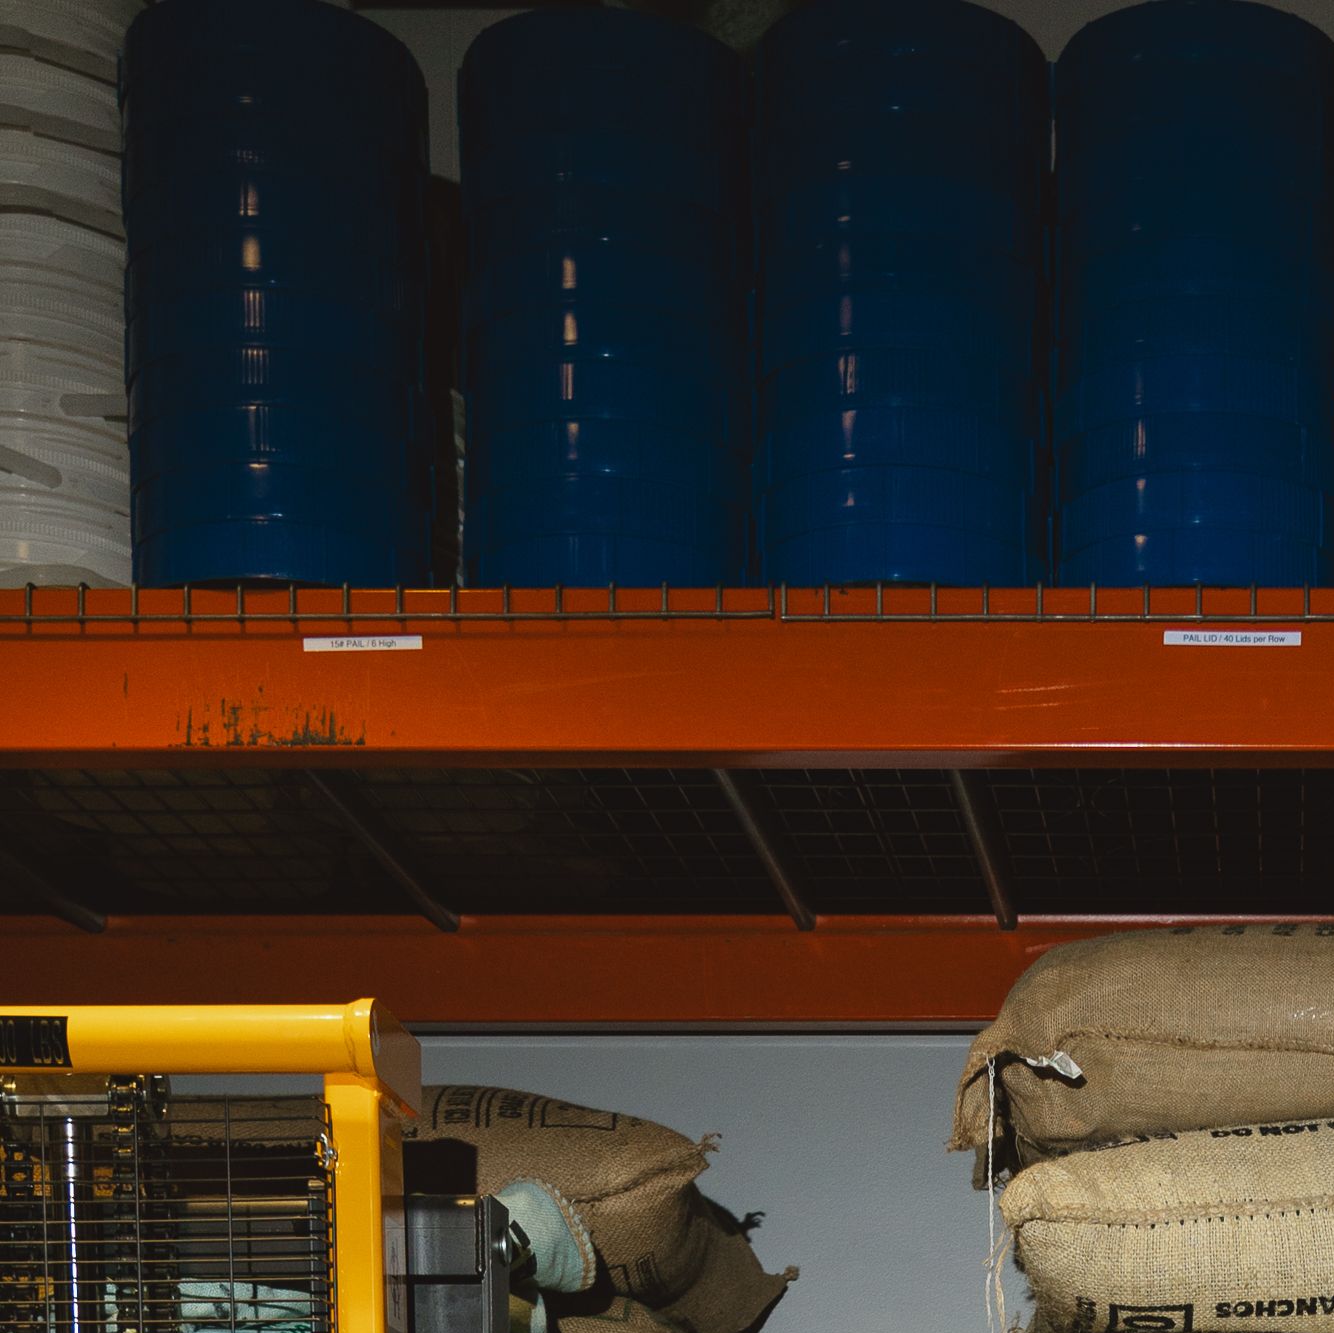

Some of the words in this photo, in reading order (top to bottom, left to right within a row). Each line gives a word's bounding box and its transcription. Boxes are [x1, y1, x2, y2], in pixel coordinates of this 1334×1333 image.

[1183, 634, 1202, 643] PAIL
[1203, 634, 1218, 643] LID
[1223, 634, 1234, 643] 40
[1235, 634, 1252, 643] Lids
[1253, 636, 1266, 645] per
[1268, 634, 1286, 643] Row
[30, 1019, 64, 1064] LBS
